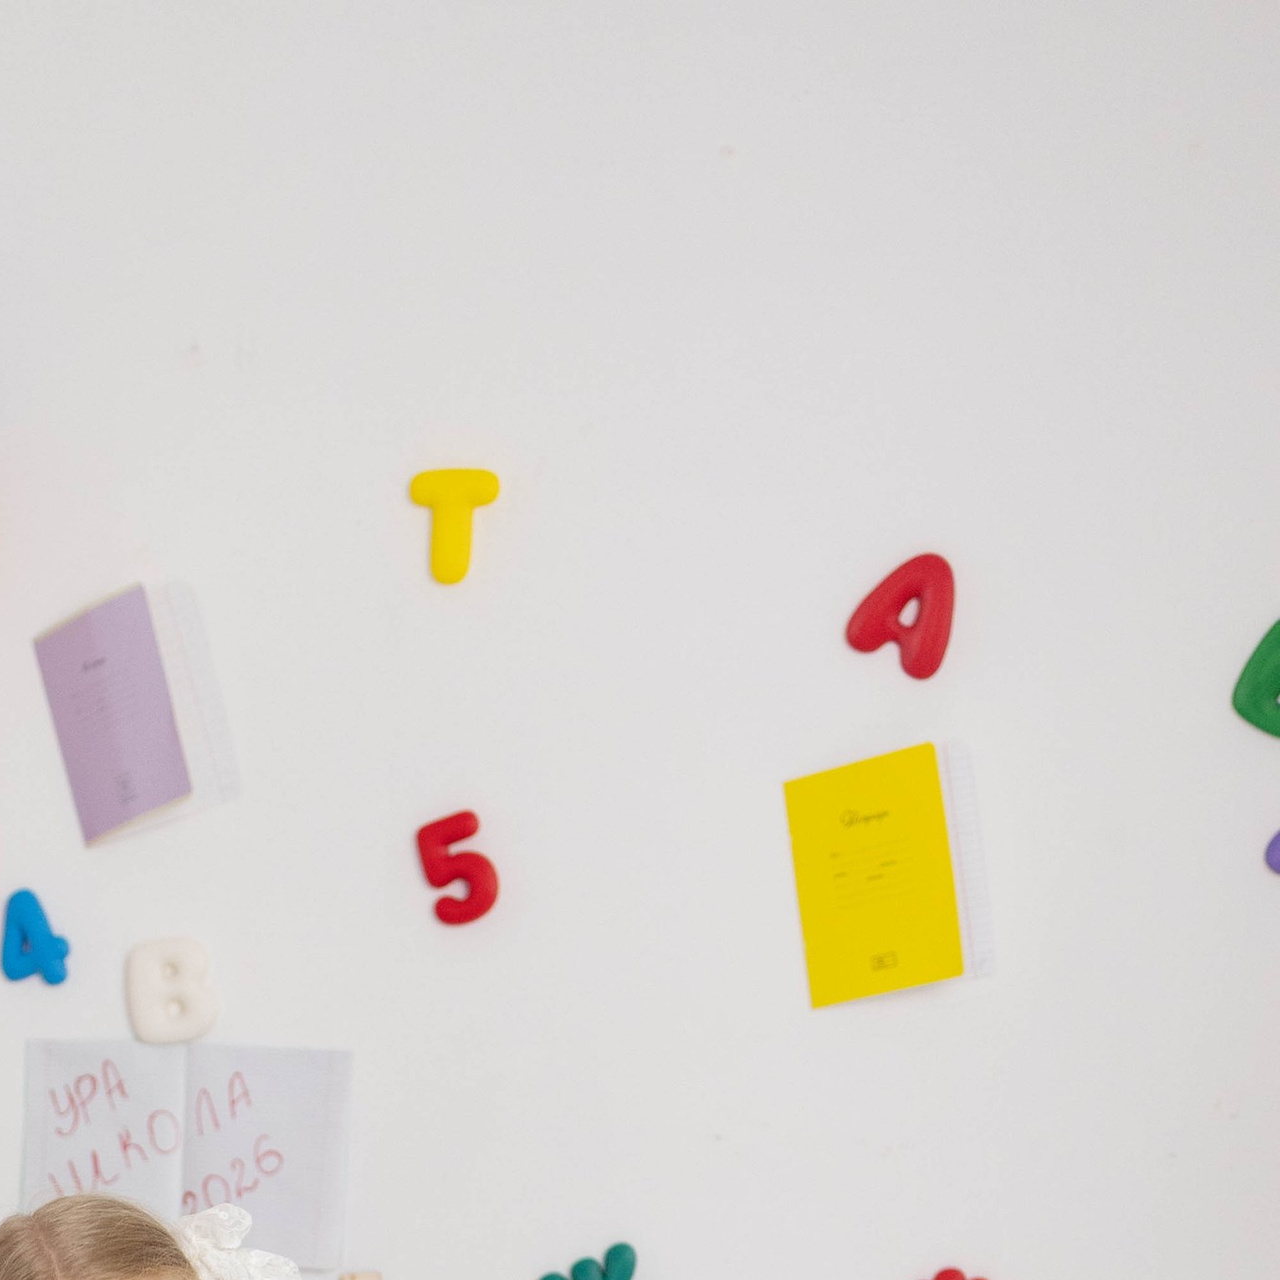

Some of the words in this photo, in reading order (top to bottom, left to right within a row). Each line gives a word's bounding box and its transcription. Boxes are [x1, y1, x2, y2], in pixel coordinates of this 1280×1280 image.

[416, 809, 499, 926] 5
[0, 889, 69, 985] 4
[48, 1058, 130, 1137] УРА
